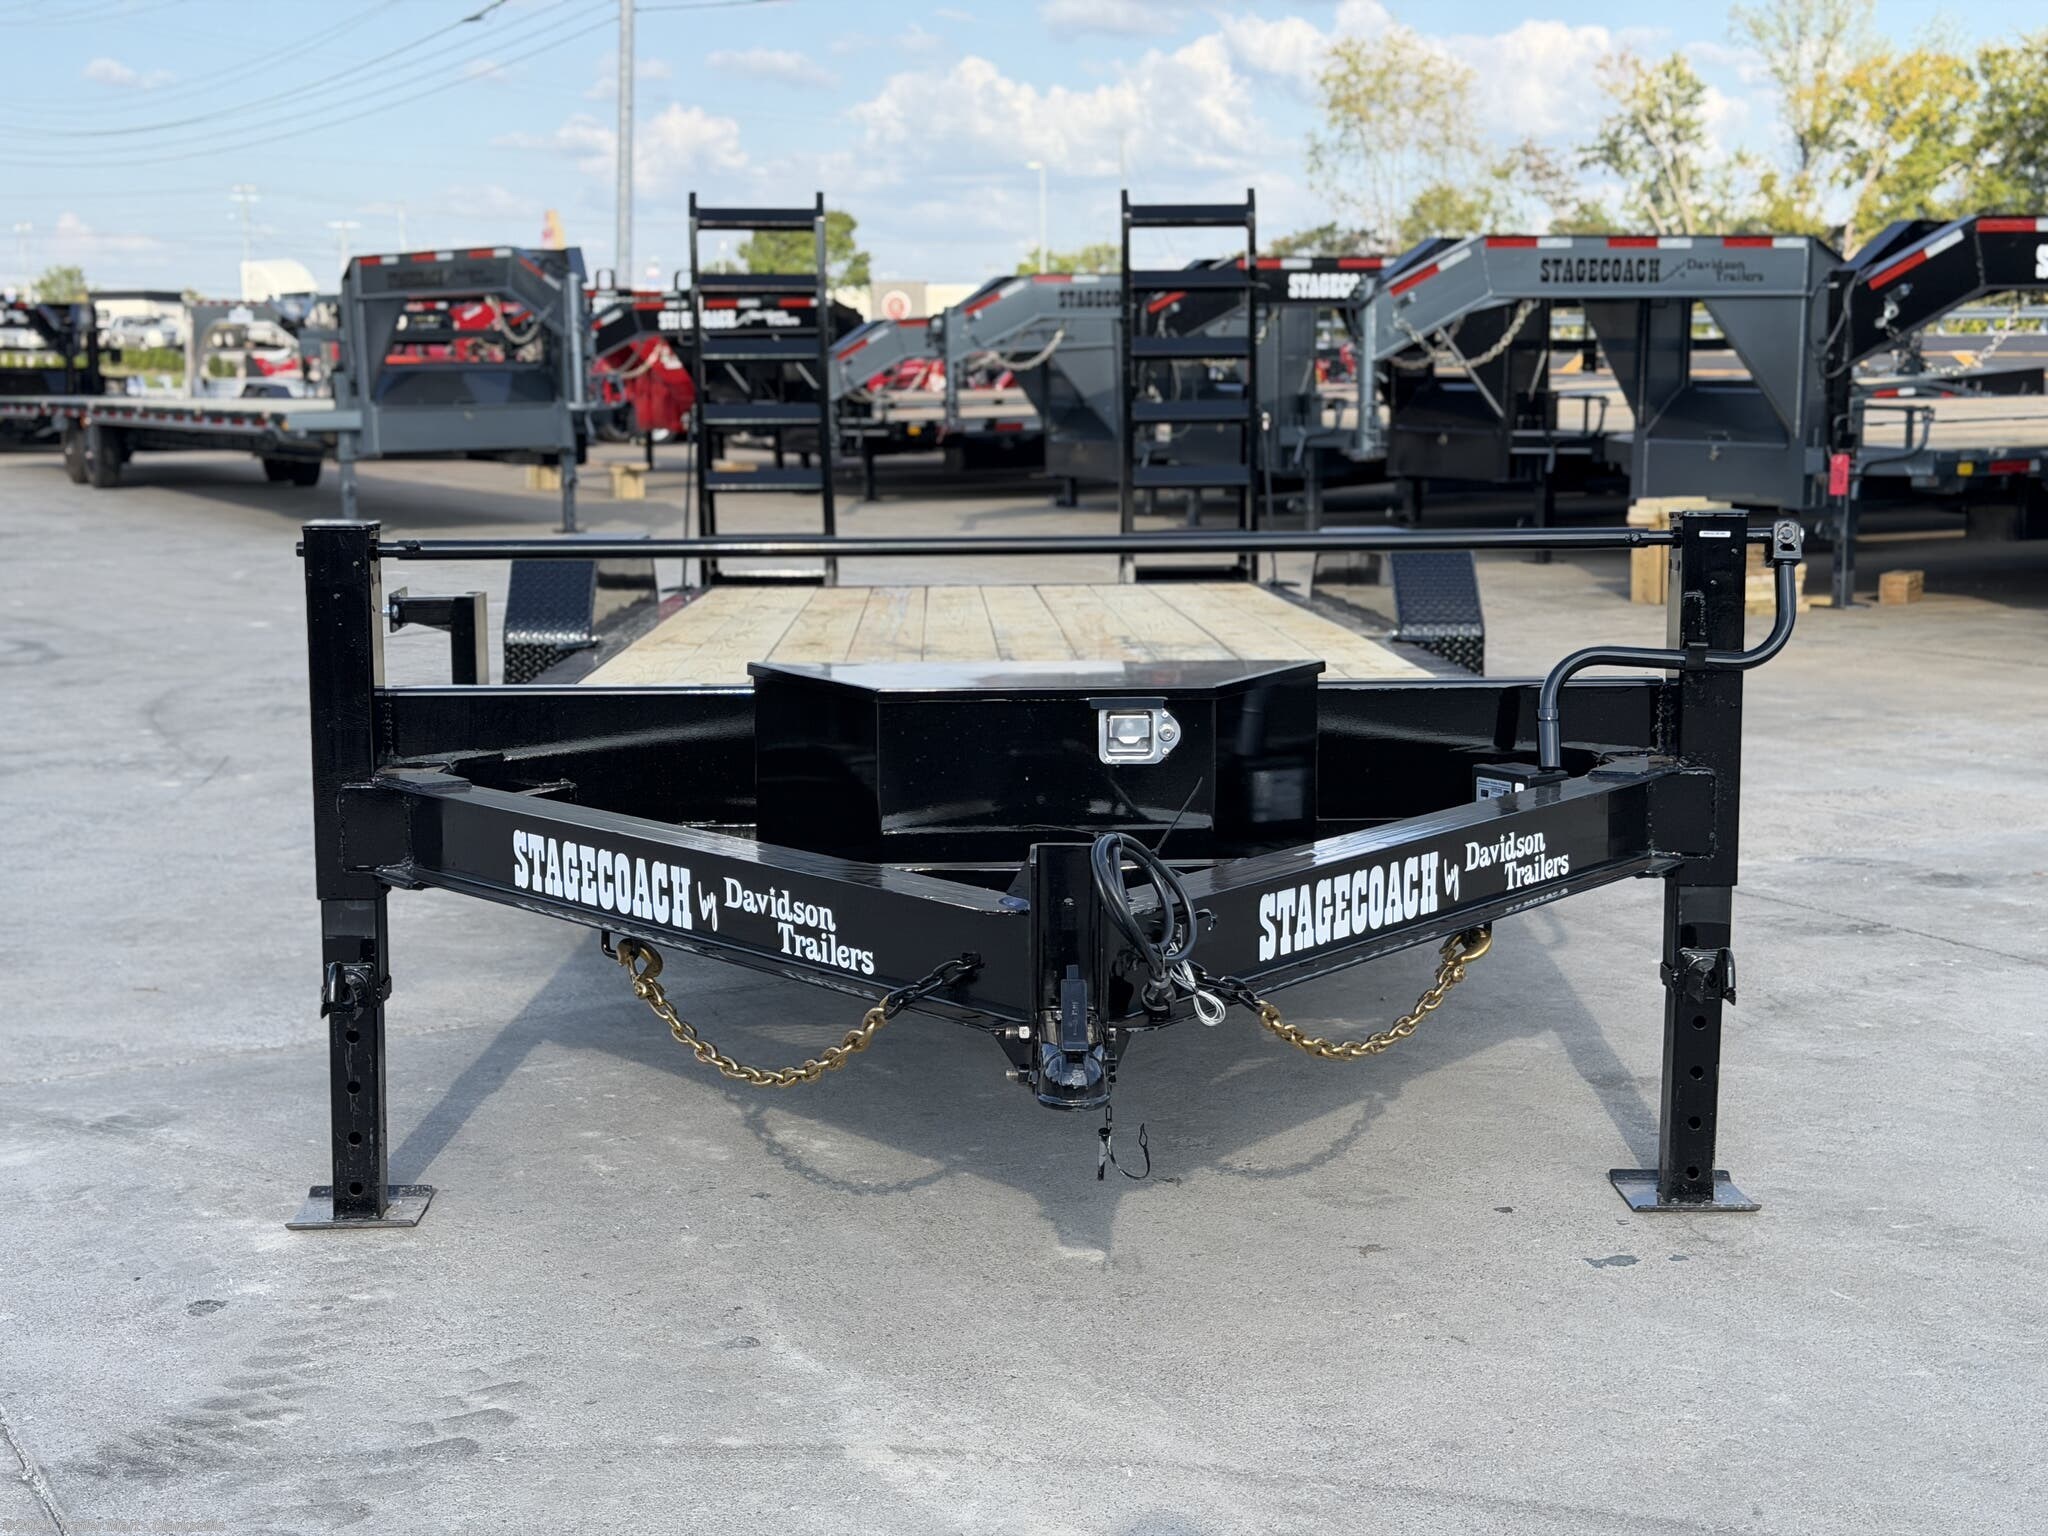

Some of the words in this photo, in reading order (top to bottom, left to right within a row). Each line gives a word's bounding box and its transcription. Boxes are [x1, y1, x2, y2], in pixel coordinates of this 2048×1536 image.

[1540, 258, 1661, 283] STAGECOACH
[1464, 831, 1546, 872] Davidson
[1503, 853, 1570, 891] Trailers
[513, 829, 693, 931] STAGECOACH
[697, 880, 718, 932] by
[723, 876, 837, 932] Davidson
[1259, 851, 1439, 962] STAGECOACH
[1443, 858, 1460, 902] by
[777, 921, 876, 975] Trailers
